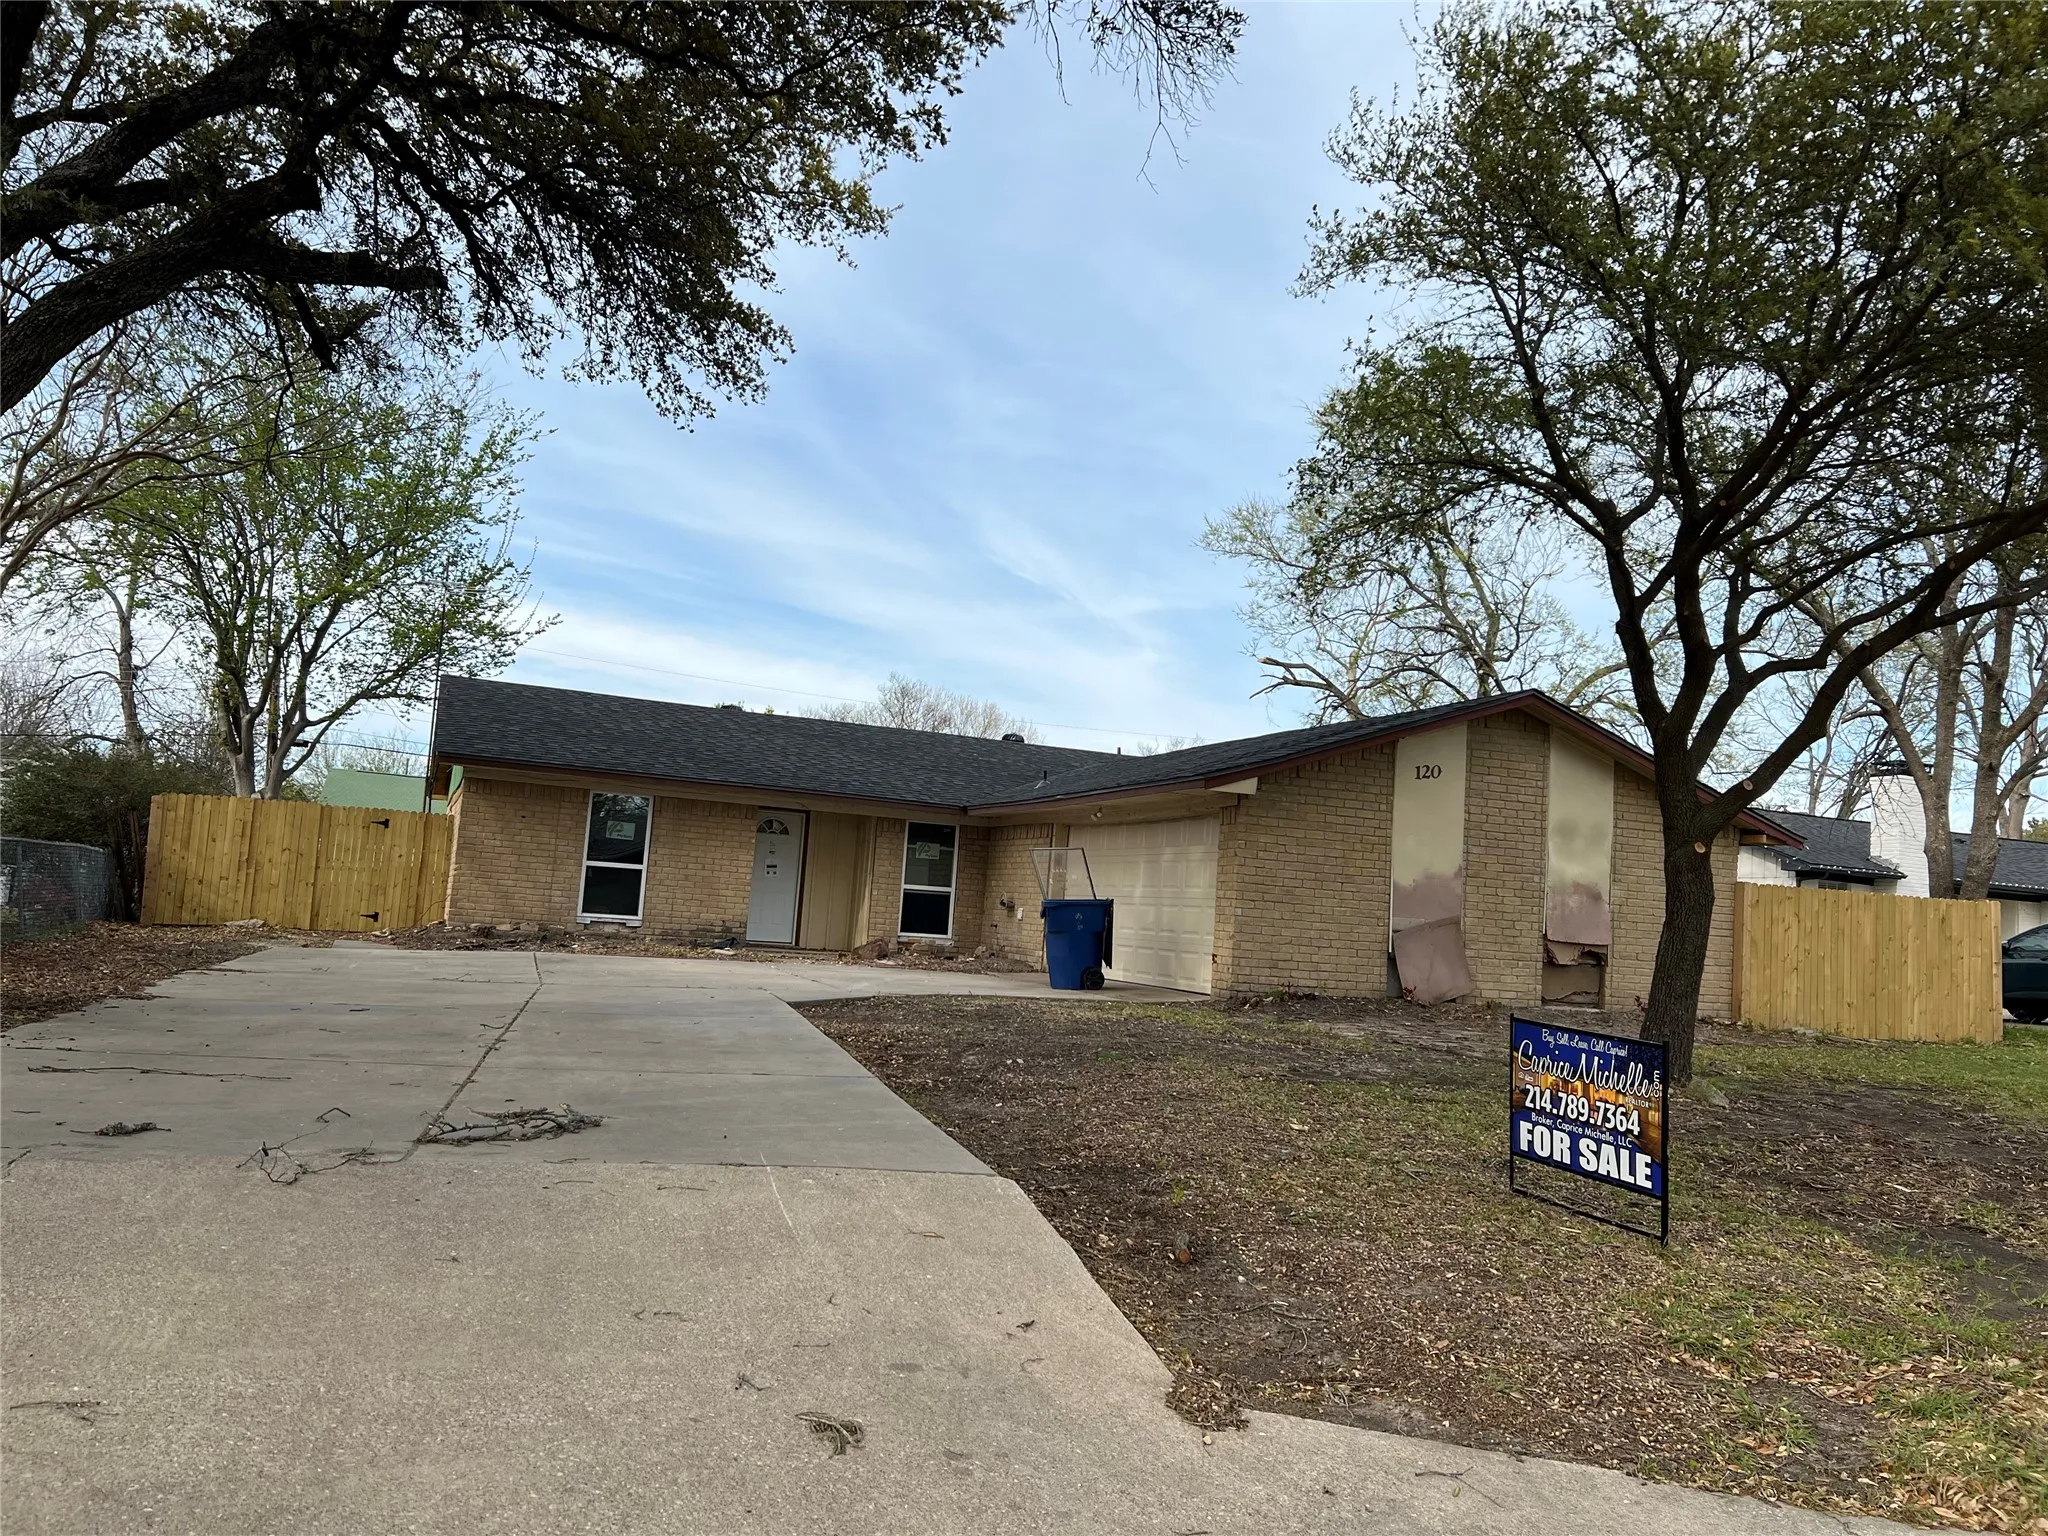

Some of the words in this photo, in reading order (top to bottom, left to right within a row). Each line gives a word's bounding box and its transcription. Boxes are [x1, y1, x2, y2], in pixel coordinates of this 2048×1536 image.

[1414, 764, 1442, 780] 120
[1524, 1084, 1641, 1135] 214.789.7364
[1531, 1112, 1555, 1128] Broker,
[1556, 1119, 1583, 1135] Caprice
[1584, 1127, 1617, 1145] Michelle,
[1617, 1135, 1633, 1148] LLC
[1519, 1120, 1571, 1165] FOR
[1578, 1137, 1653, 1189] SALE
